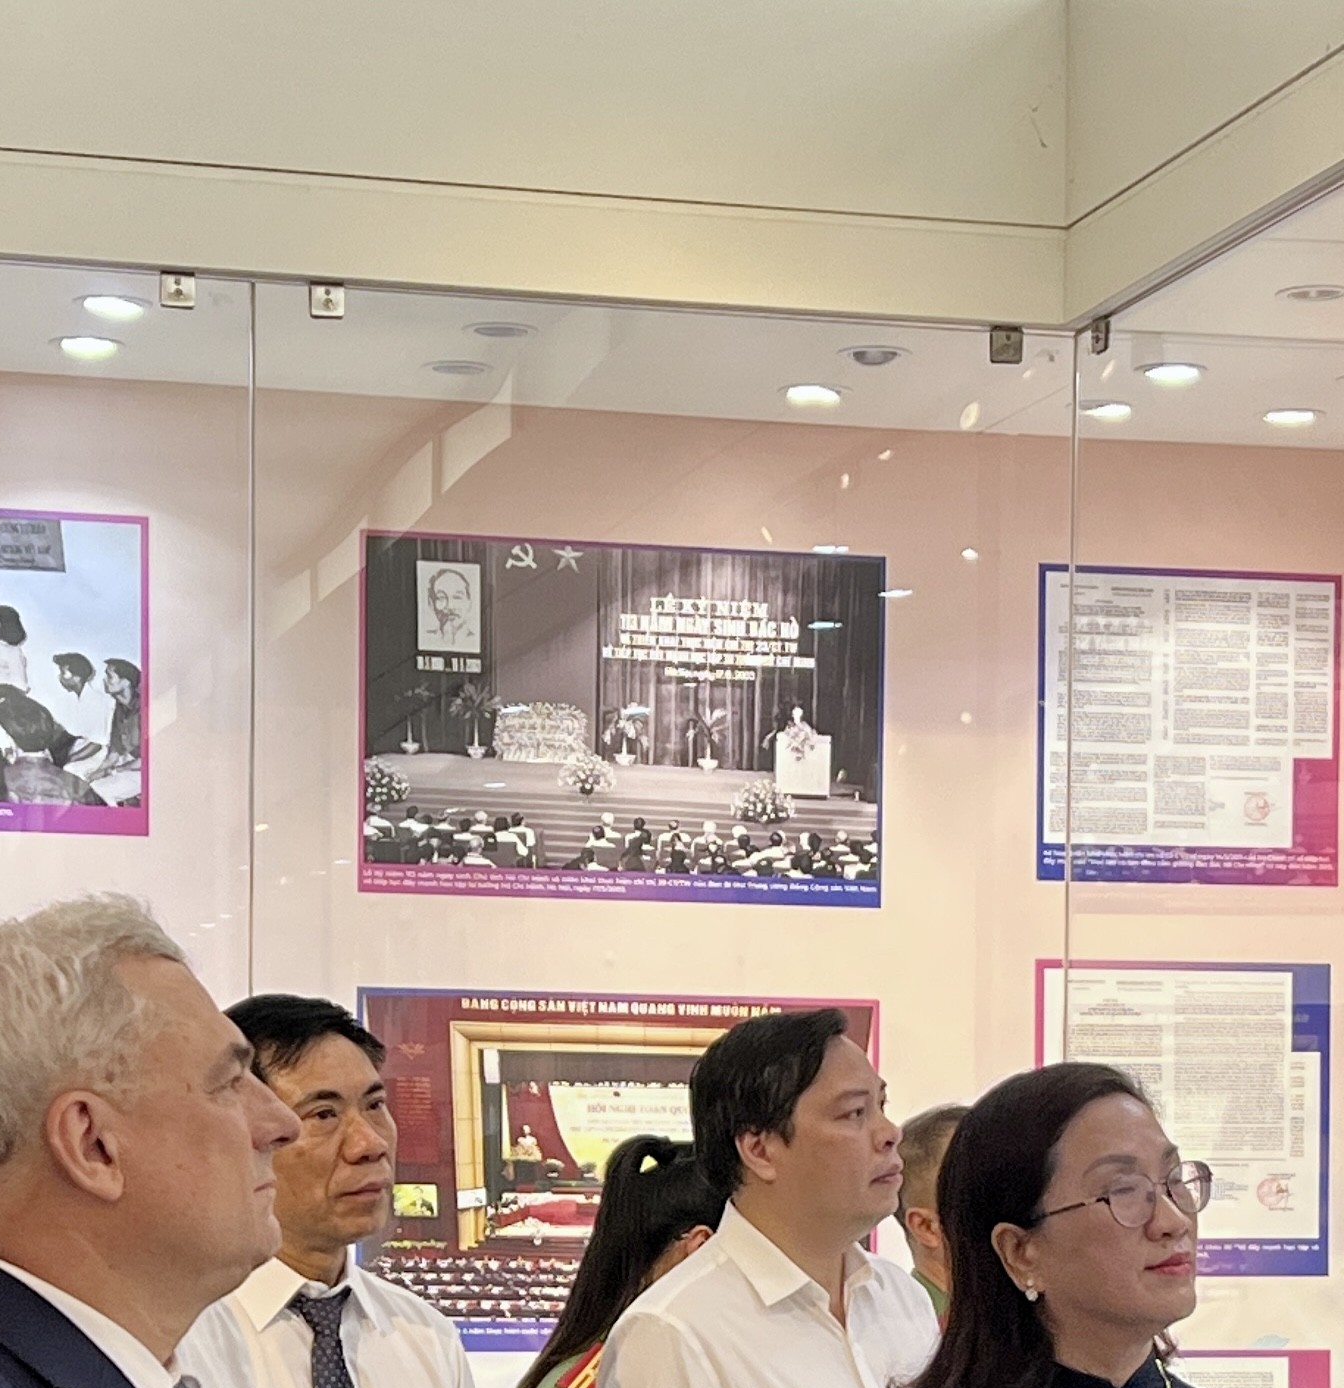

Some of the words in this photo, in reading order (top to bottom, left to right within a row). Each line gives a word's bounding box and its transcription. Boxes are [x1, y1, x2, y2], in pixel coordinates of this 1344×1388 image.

[501, 997, 537, 1014] CỘNG
[568, 999, 596, 1016] VIỆT
[598, 1001, 629, 1014] NAM
[631, 1001, 676, 1016] QUANG
[678, 1003, 709, 1017] VINH
